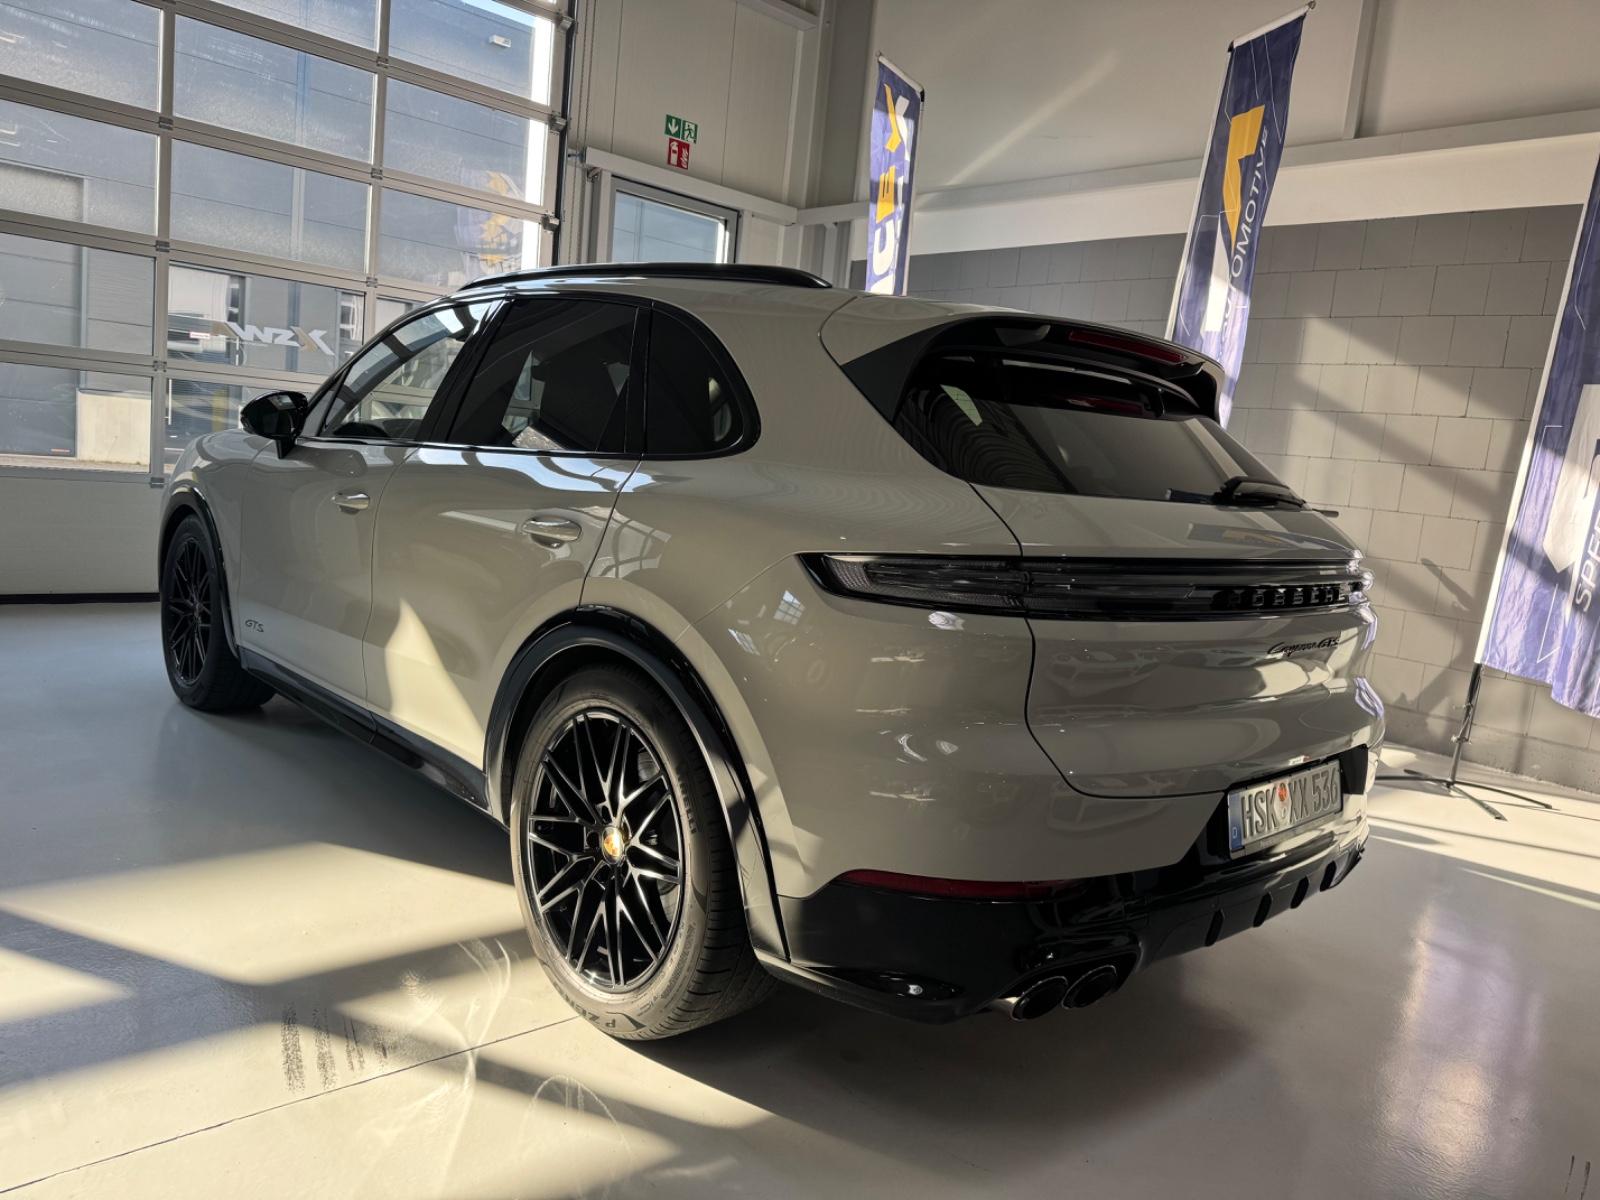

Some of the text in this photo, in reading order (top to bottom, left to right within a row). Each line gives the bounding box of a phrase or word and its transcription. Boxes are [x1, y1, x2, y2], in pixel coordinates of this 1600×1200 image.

[245, 619, 264, 632] GTS
[1241, 767, 1338, 839] HSK XX 536
